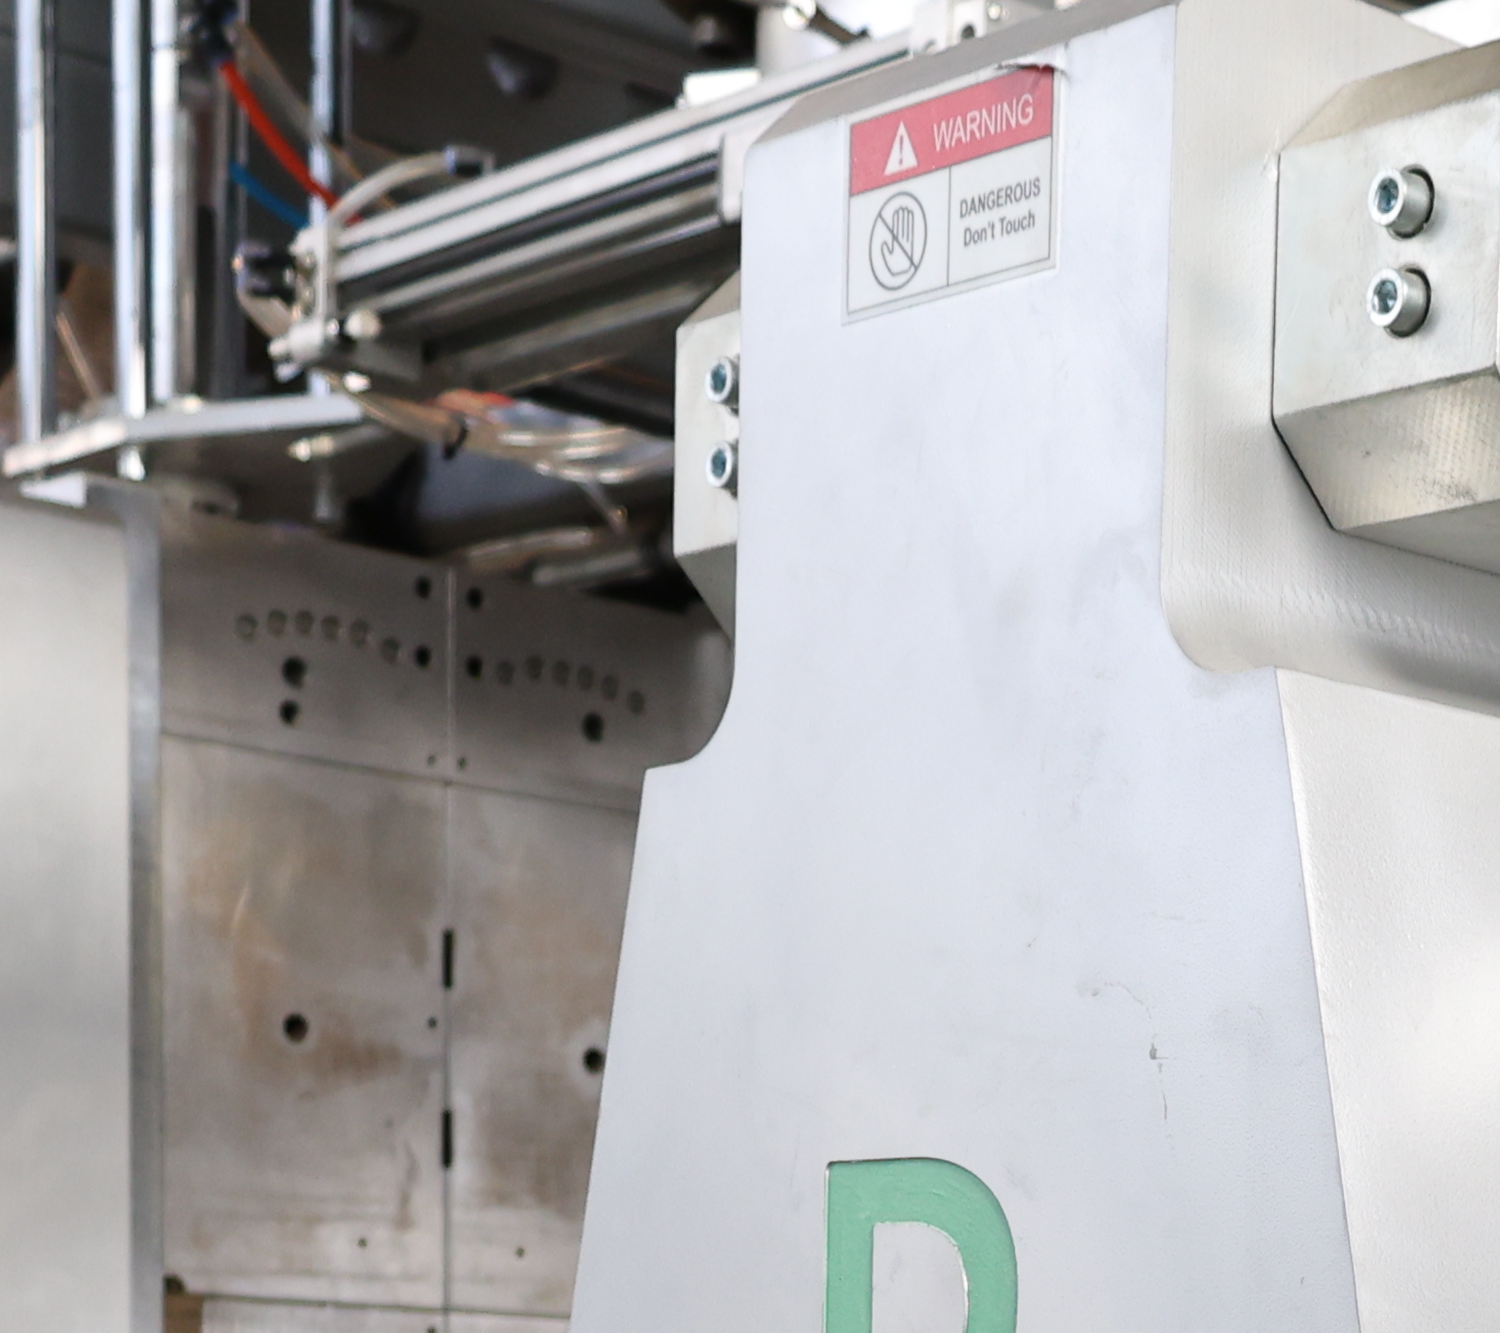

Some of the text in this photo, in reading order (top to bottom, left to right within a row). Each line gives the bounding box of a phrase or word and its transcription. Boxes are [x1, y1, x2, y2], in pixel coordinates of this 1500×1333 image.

[933, 93, 1034, 151] WARNING
[960, 177, 1041, 218] DANGEROUS
[963, 210, 1035, 247] Don't Touch
